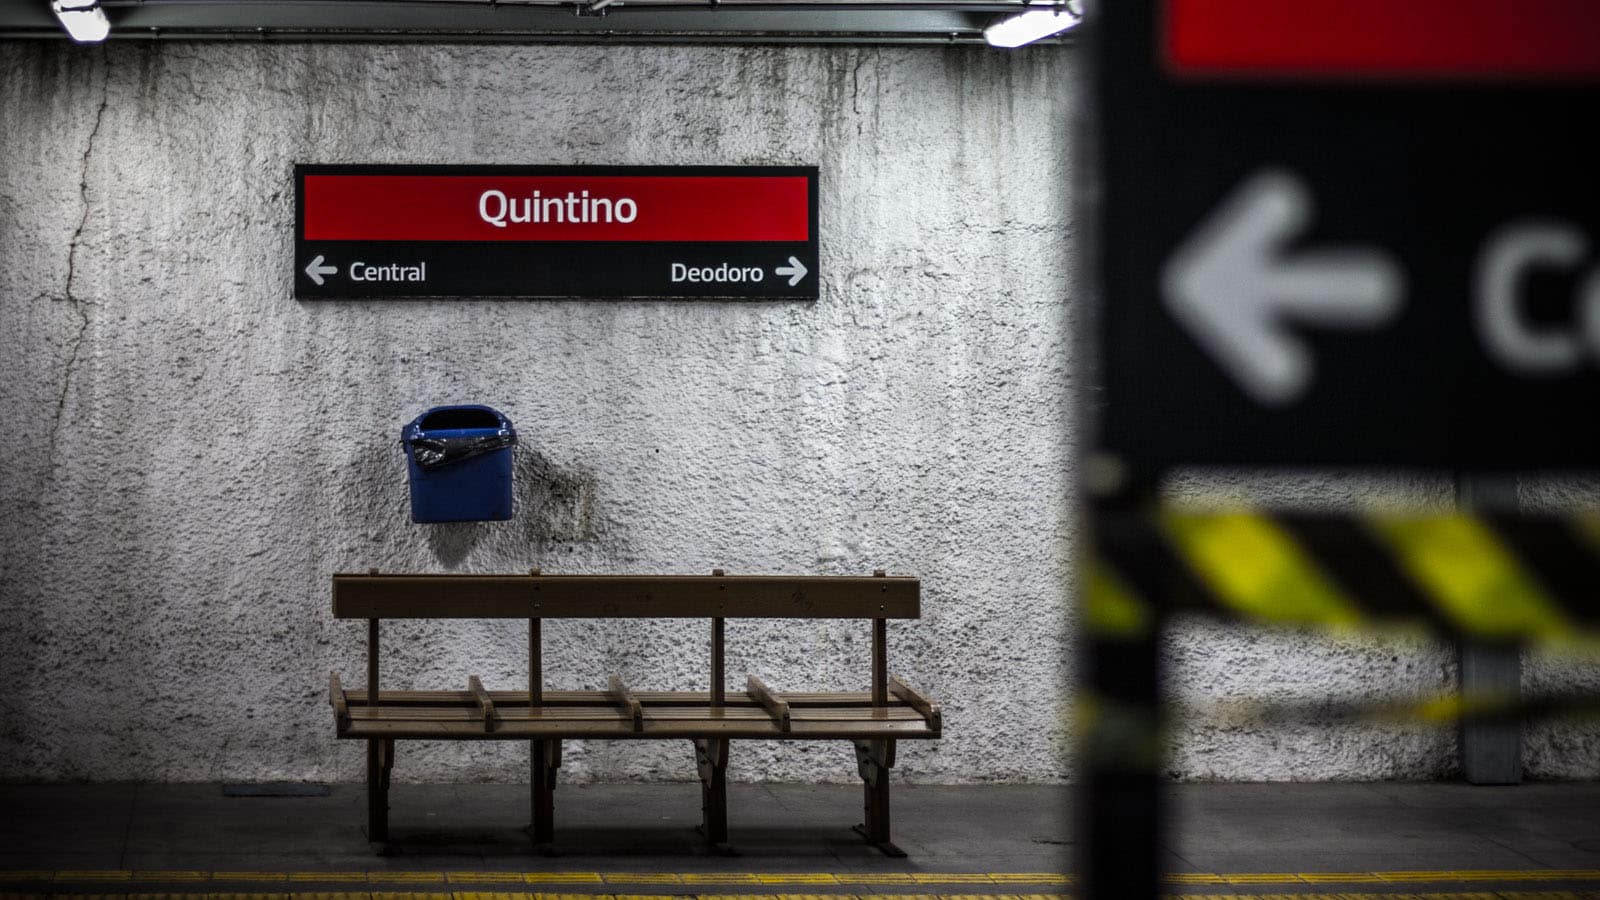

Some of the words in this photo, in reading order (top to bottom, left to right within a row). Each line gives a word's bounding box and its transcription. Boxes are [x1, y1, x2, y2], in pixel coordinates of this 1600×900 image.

[478, 189, 638, 228] Quintino
[349, 261, 426, 283] Central
[671, 262, 764, 283] Deodoro
